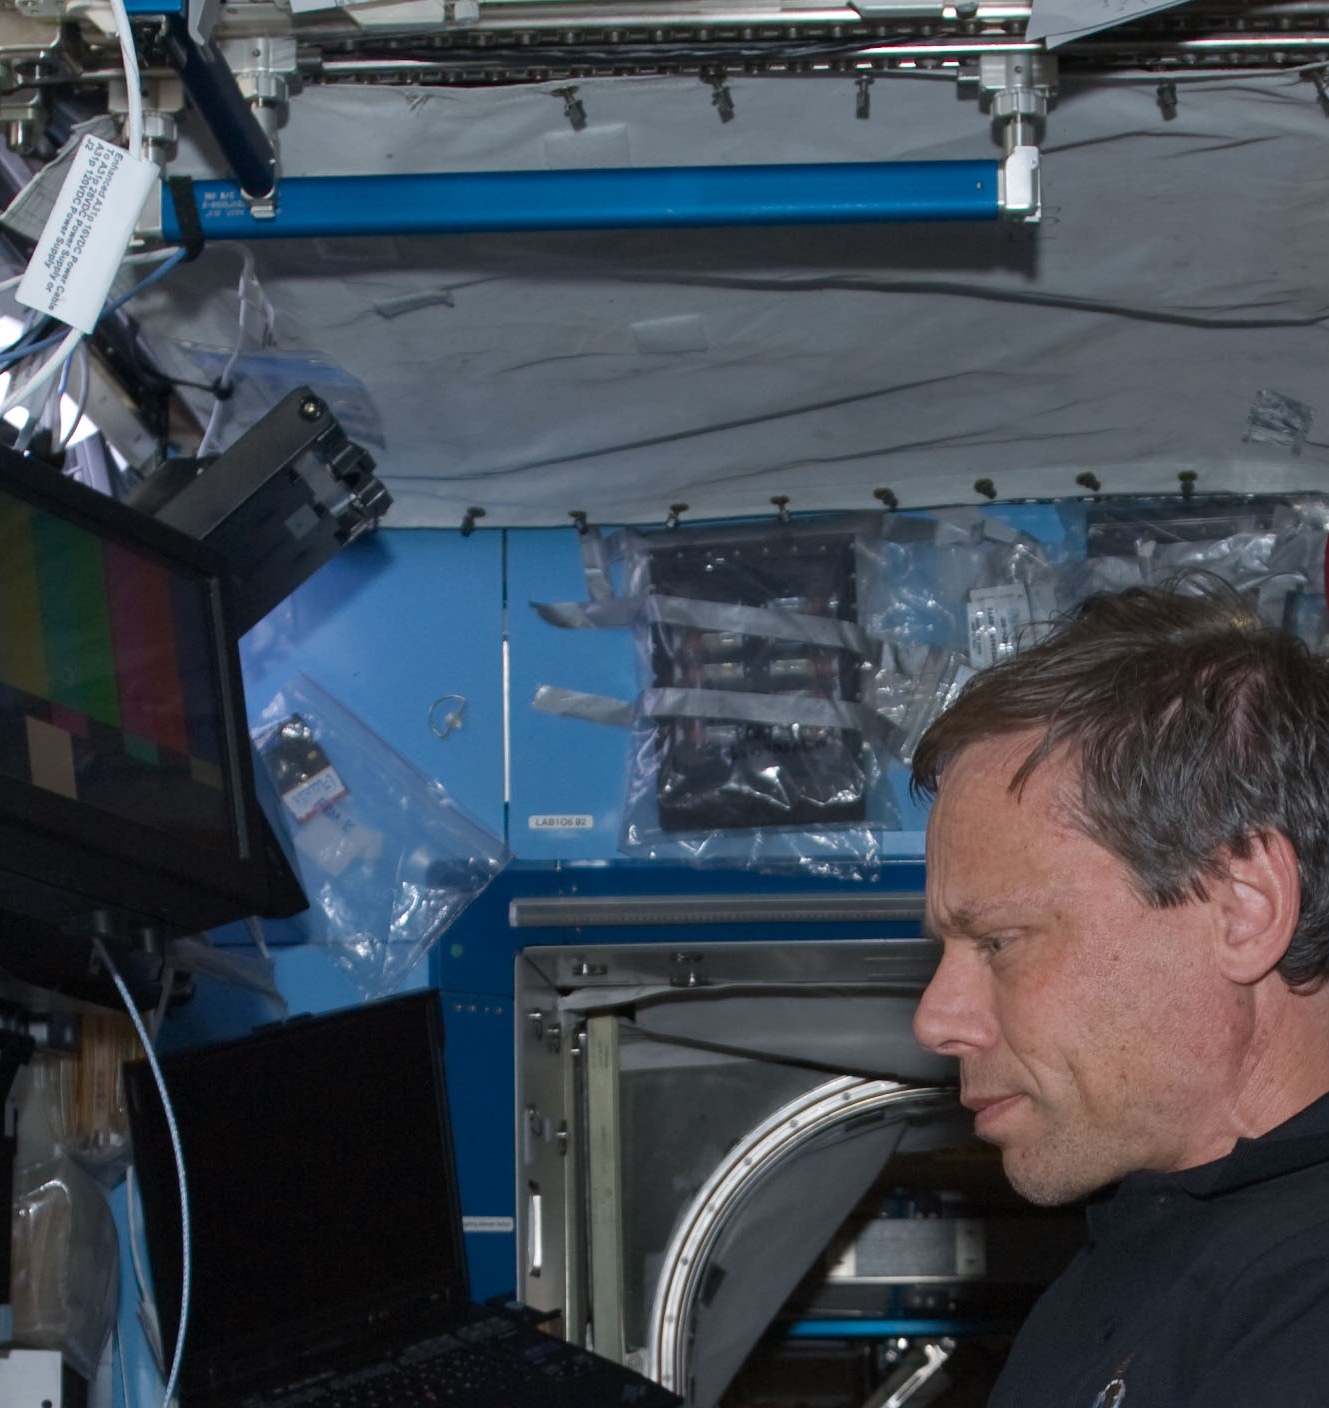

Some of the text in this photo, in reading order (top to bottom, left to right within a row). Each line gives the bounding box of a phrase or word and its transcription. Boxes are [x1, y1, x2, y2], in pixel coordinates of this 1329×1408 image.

[44, 142, 104, 268] A31p 120VDC Power Supply
[85, 139, 95, 151] J2
[45, 148, 114, 292] To A31p 28VDC Power Supply or
[47, 152, 123, 310] Enhanced A31p 16VDC Power Cable
